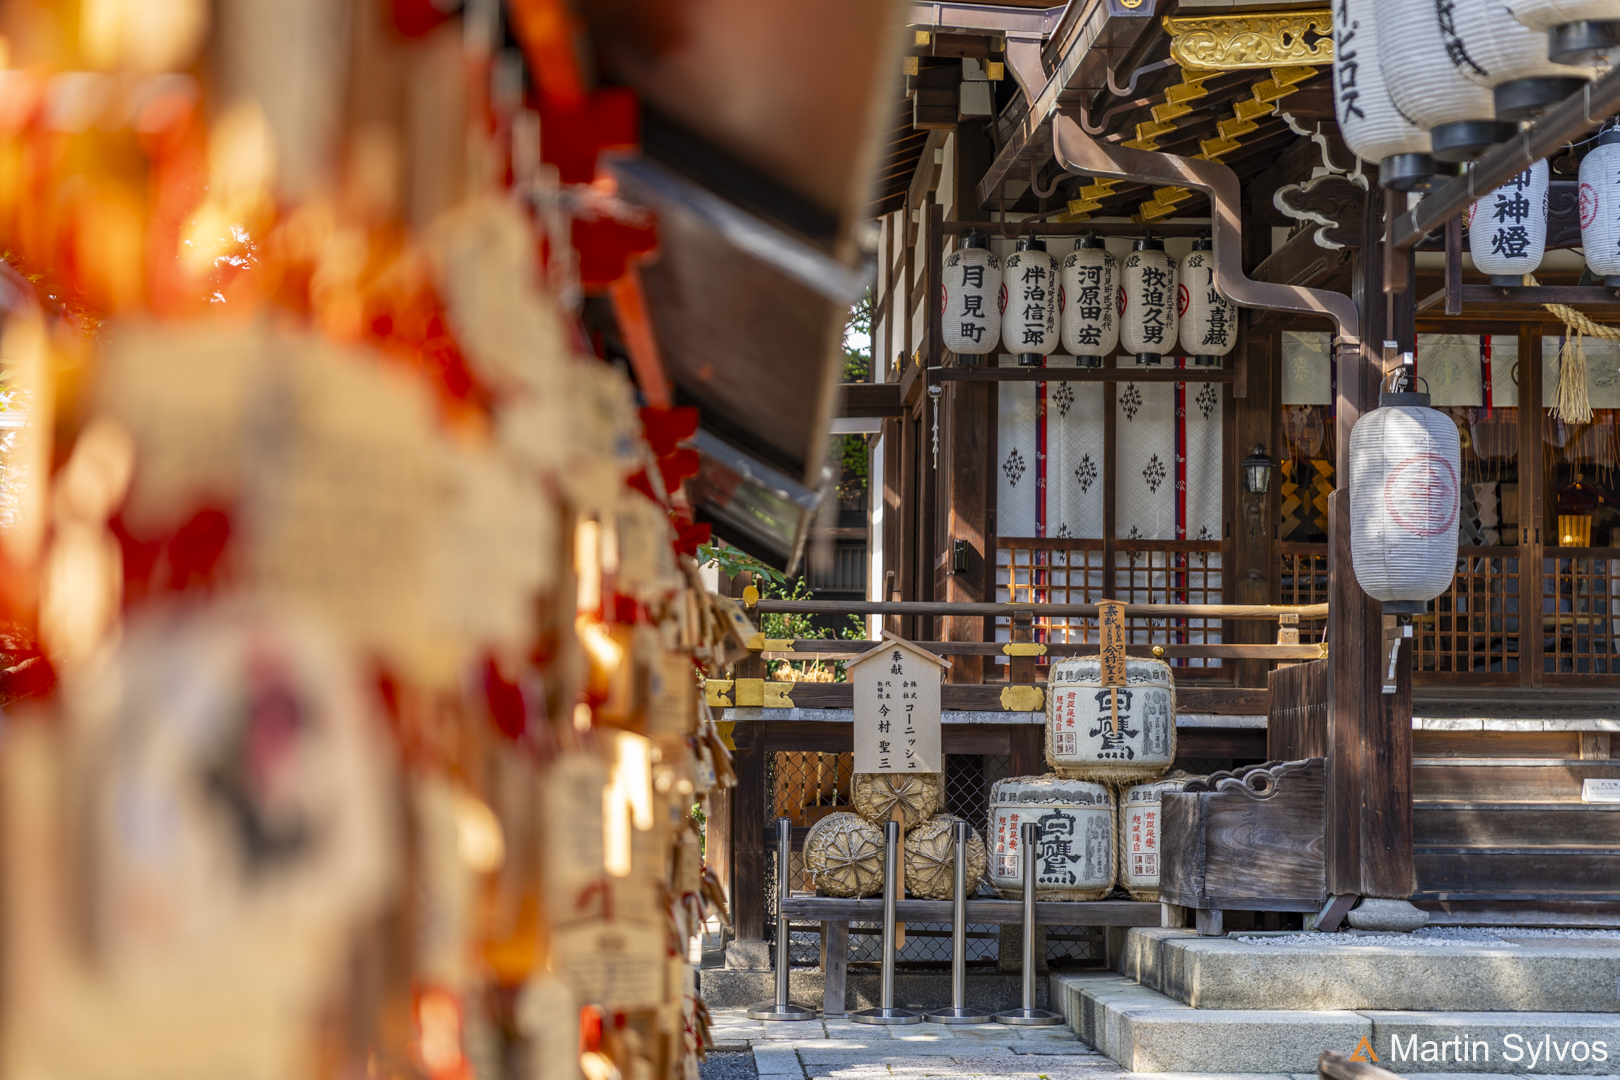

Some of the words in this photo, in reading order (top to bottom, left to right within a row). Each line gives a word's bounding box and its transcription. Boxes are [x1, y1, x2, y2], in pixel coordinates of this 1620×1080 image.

[960, 264, 986, 344] 月見町
[1076, 265, 1103, 346] 河原田宏
[1141, 266, 1167, 345] 牧迫久男
[891, 650, 903, 675] 奉献
[904, 704, 917, 769] コーニッシュ
[1037, 808, 1082, 885] 白鷹
